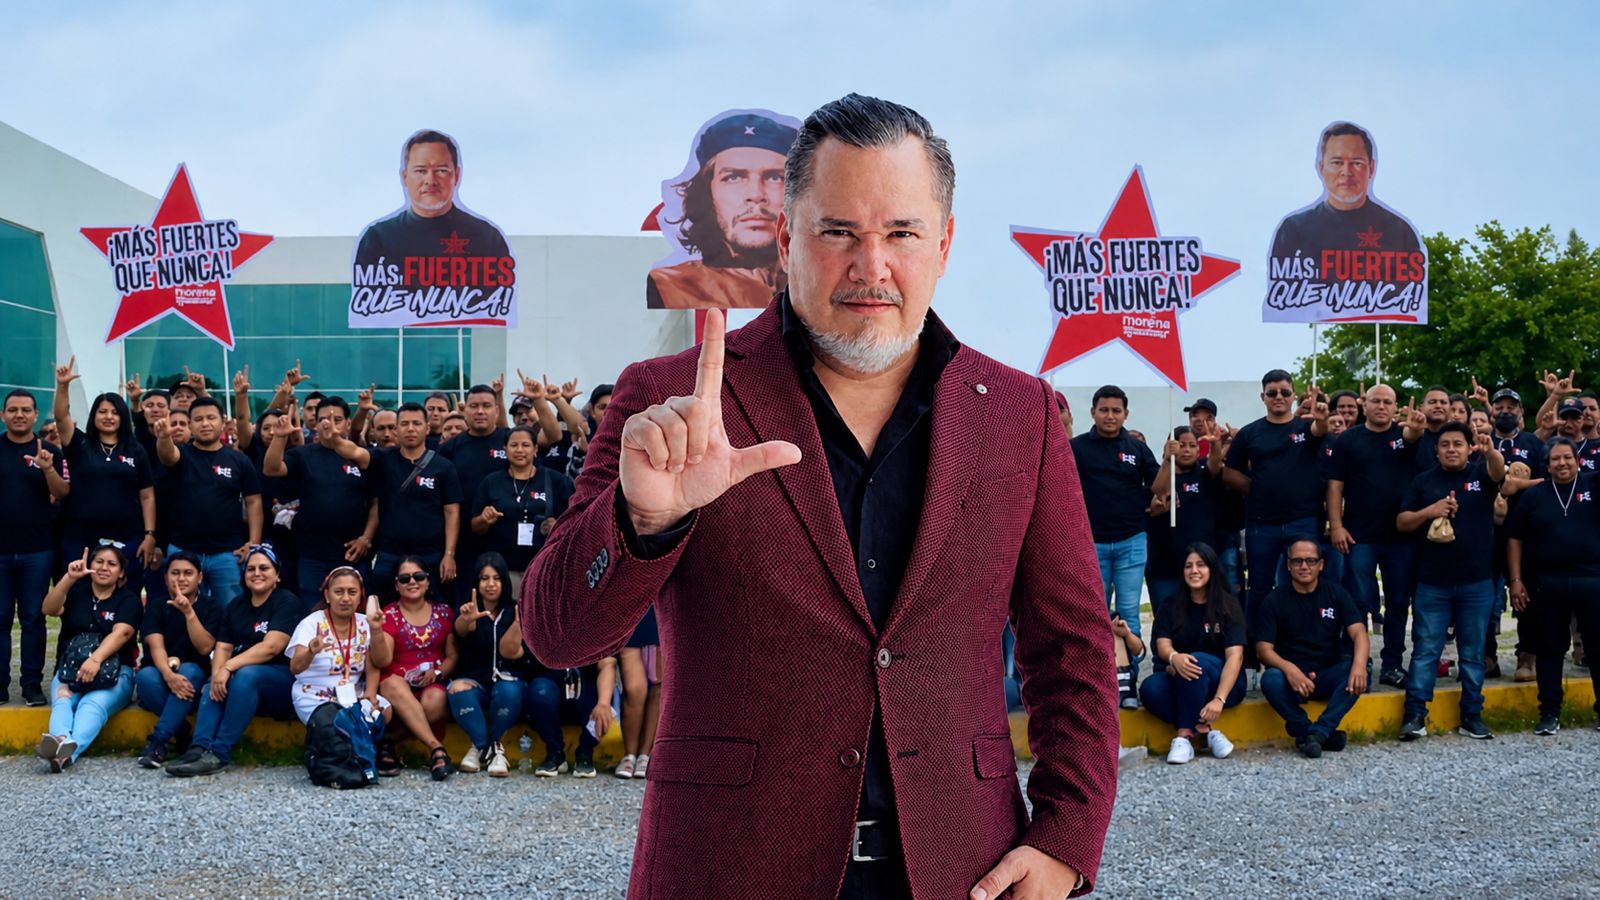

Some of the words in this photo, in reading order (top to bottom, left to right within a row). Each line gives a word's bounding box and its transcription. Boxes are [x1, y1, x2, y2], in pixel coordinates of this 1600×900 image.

[108, 225, 156, 267] ¡MÁS
[161, 221, 238, 255] FUERTES
[1045, 233, 1103, 282] ¡MÁS
[1109, 239, 1200, 274] FUERTES
[114, 260, 153, 293] QUE
[157, 250, 232, 286] NUNCA!
[404, 256, 515, 287] FUERTES
[1321, 249, 1425, 281] FUERTES
[352, 286, 410, 316] QUE
[409, 286, 513, 318] NUNCA!
[1052, 278, 1096, 316] QUE
[1104, 275, 1191, 312] NUNCA!
[1268, 279, 1326, 310] QUE
[1325, 279, 1424, 313] NUNCA!
[1122, 315, 1170, 329] morena
